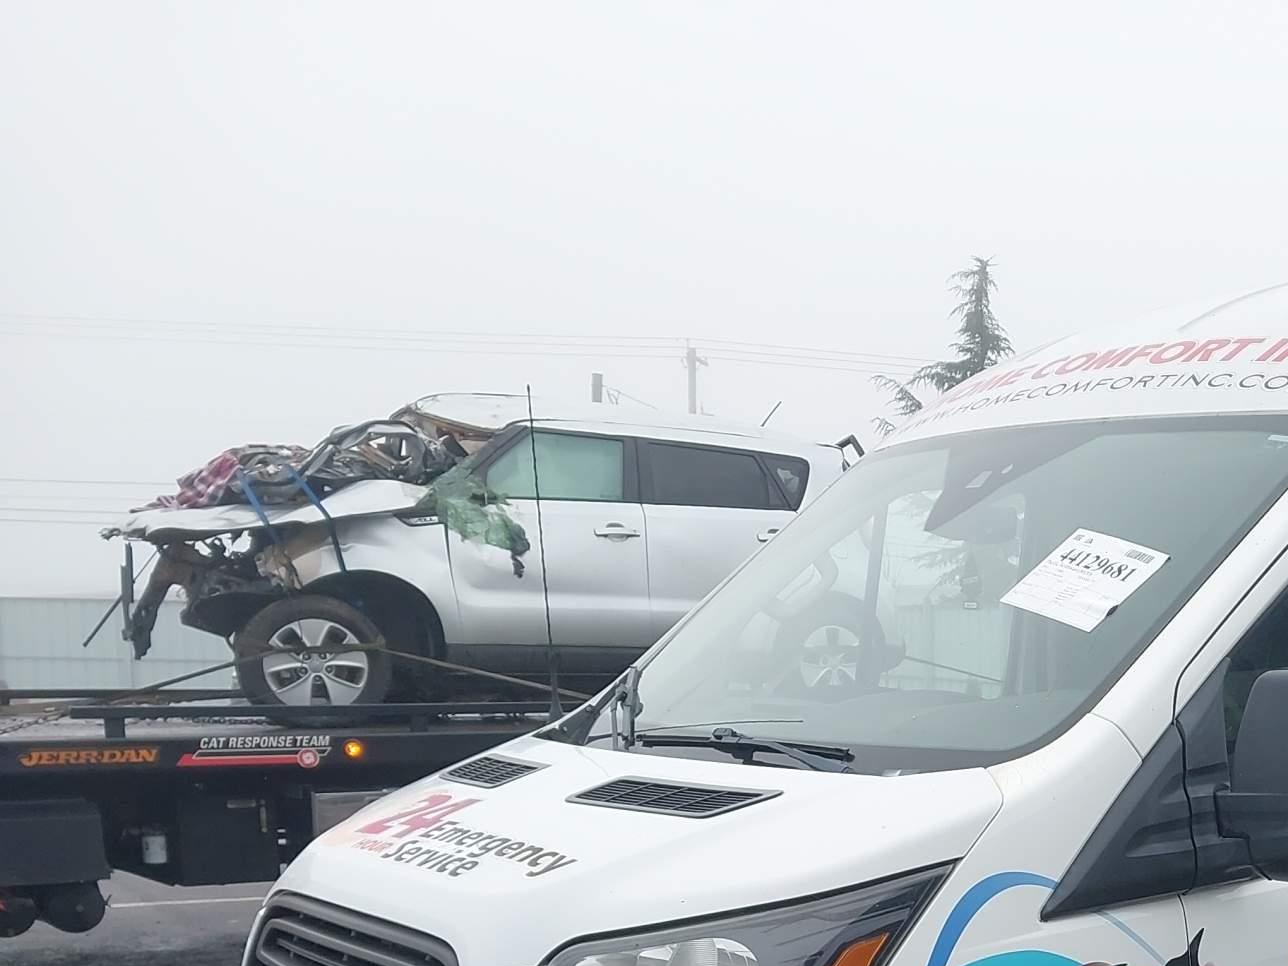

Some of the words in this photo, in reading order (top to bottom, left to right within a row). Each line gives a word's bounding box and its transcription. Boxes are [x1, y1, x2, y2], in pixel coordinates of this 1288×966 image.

[1030, 337, 1267, 382] COMFORT
[1059, 548, 1139, 582] 44129681
[199, 737, 226, 749] CAT
[227, 735, 293, 749] RESPONSE
[295, 734, 330, 747] TEAM
[354, 794, 484, 839] 24
[419, 820, 578, 877] Emergency
[379, 839, 480, 878] Service
